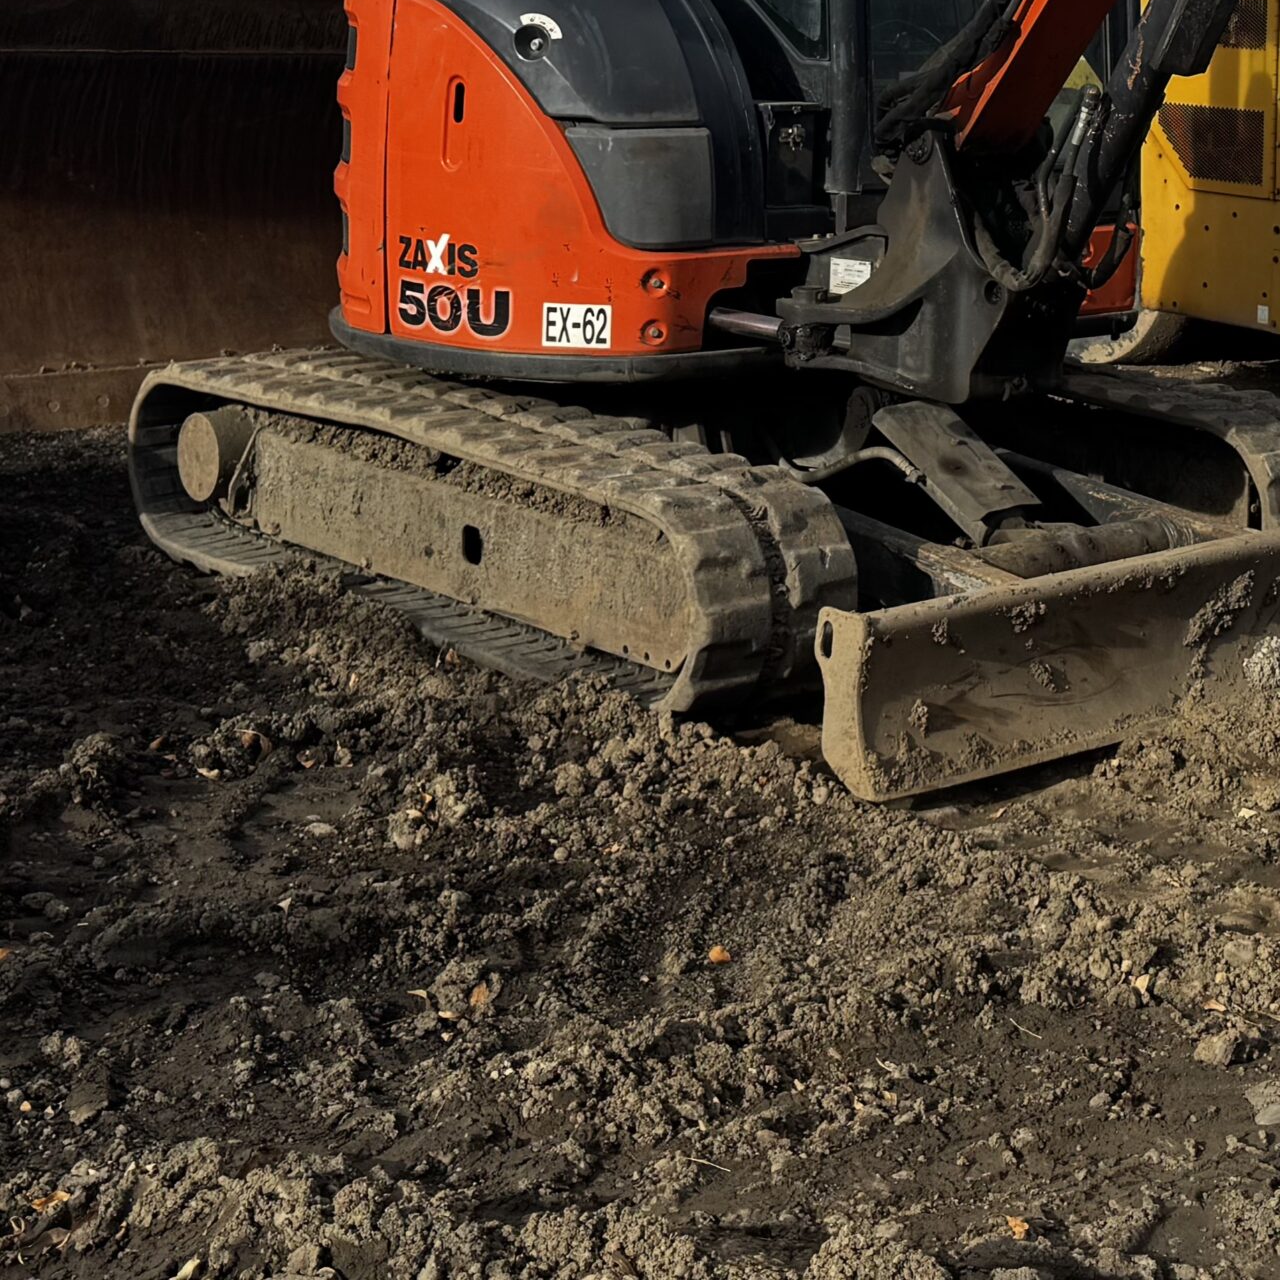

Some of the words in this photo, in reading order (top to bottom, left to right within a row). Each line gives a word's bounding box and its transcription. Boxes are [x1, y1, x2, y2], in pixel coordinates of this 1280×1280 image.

[399, 233, 479, 278] ZAXIS
[398, 278, 510, 337] 50U
[546, 306, 608, 345] EX-62
